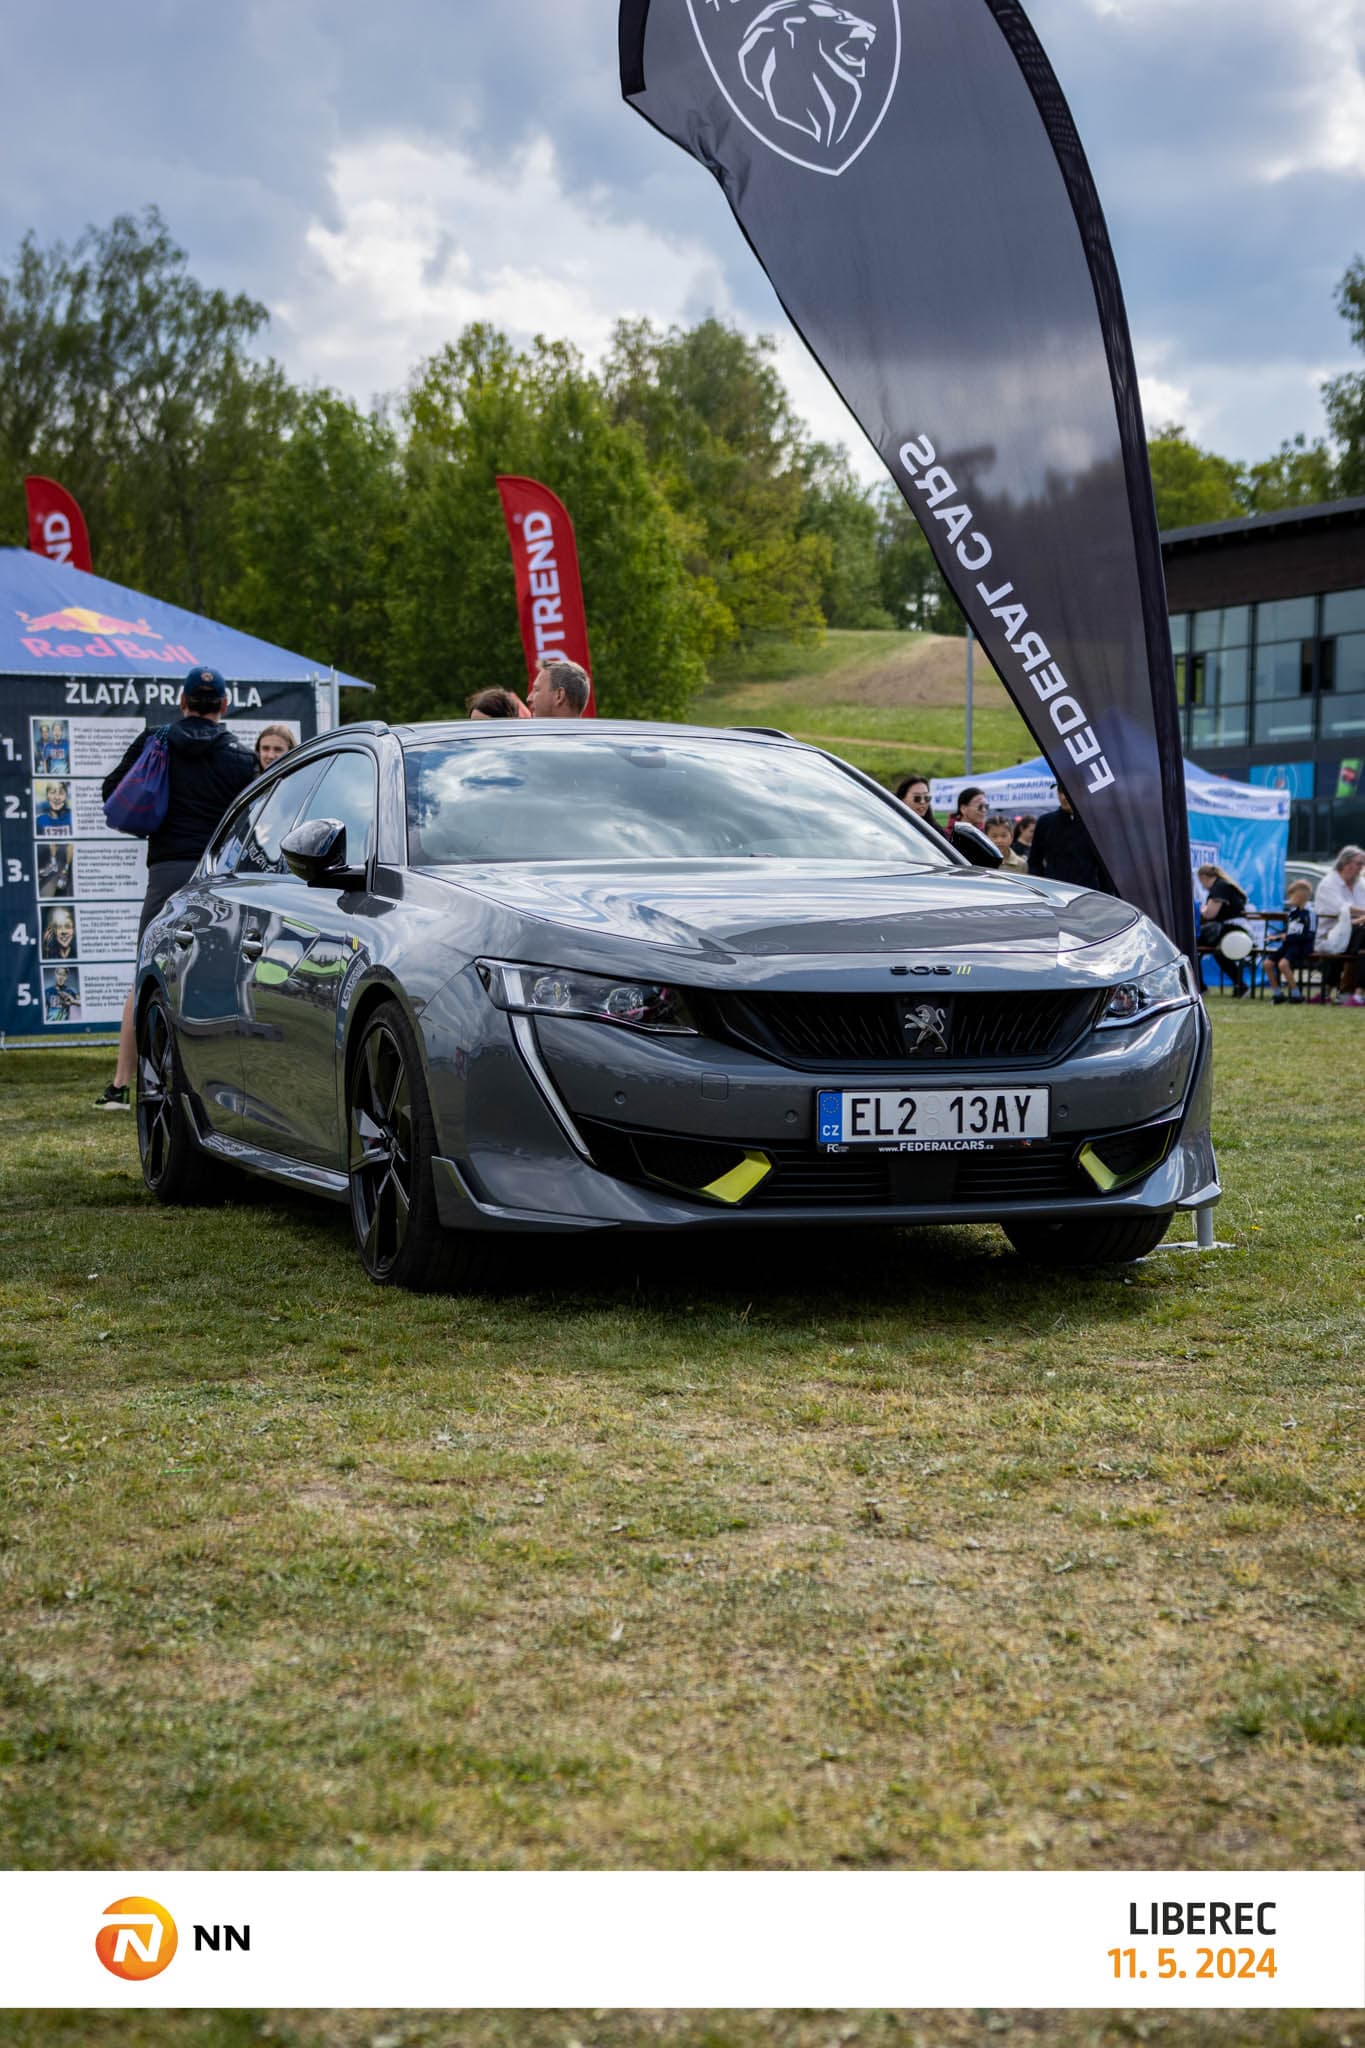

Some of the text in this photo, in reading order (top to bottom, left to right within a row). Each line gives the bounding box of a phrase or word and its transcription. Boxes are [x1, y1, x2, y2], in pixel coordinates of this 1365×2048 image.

[20, 636, 200, 665] Red Bull
[145, 682, 262, 708] PRLA
[2, 738, 22, 761] 1.
[4, 795, 28, 819] 2.
[7, 859, 30, 883] 3.
[11, 923, 37, 945] 4.
[17, 983, 39, 1007] 5.
[851, 1095, 1031, 1137] EL2 13AY
[822, 1125, 839, 1136] CZ
